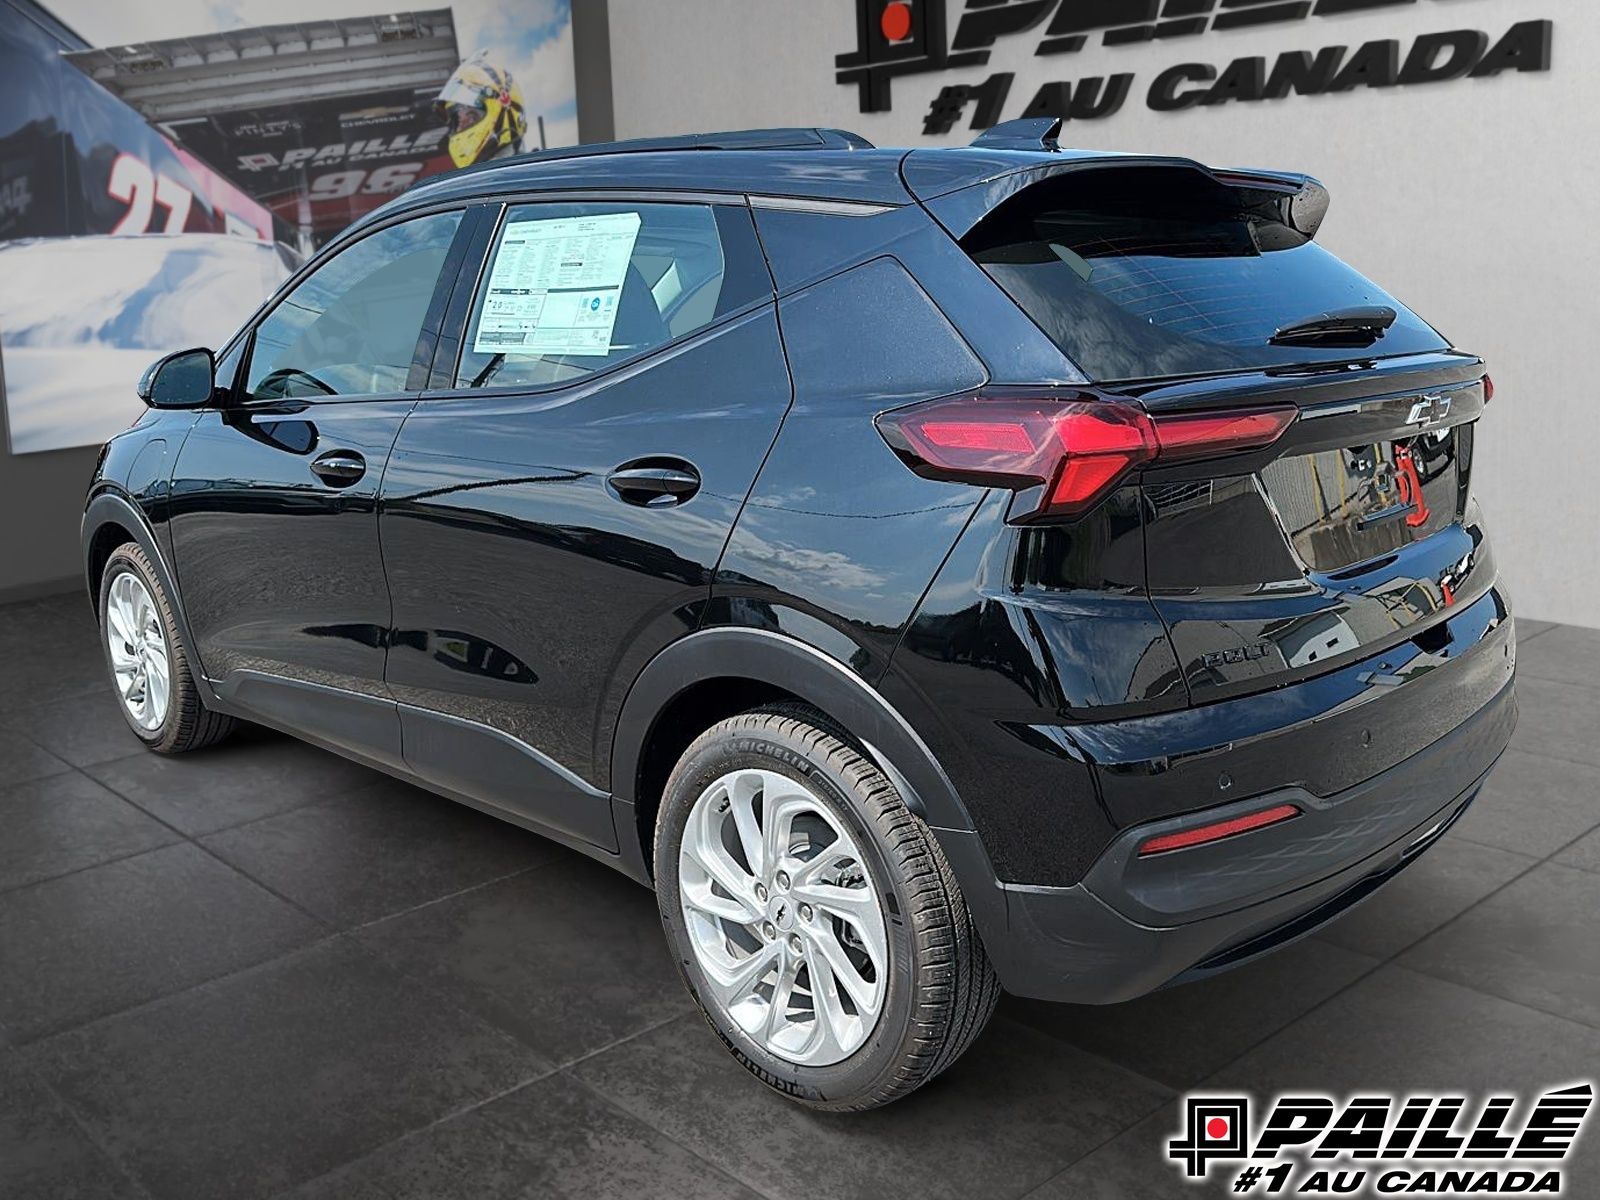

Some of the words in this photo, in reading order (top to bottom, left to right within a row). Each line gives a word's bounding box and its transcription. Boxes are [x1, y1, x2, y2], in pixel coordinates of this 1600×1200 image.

[921, 72, 1015, 135] #1
[1020, 73, 1136, 121] AU
[1146, 19, 1552, 112] CANADA
[350, 145, 438, 161] CANADA
[311, 162, 424, 199] 96
[738, 741, 810, 773] MICHELIN
